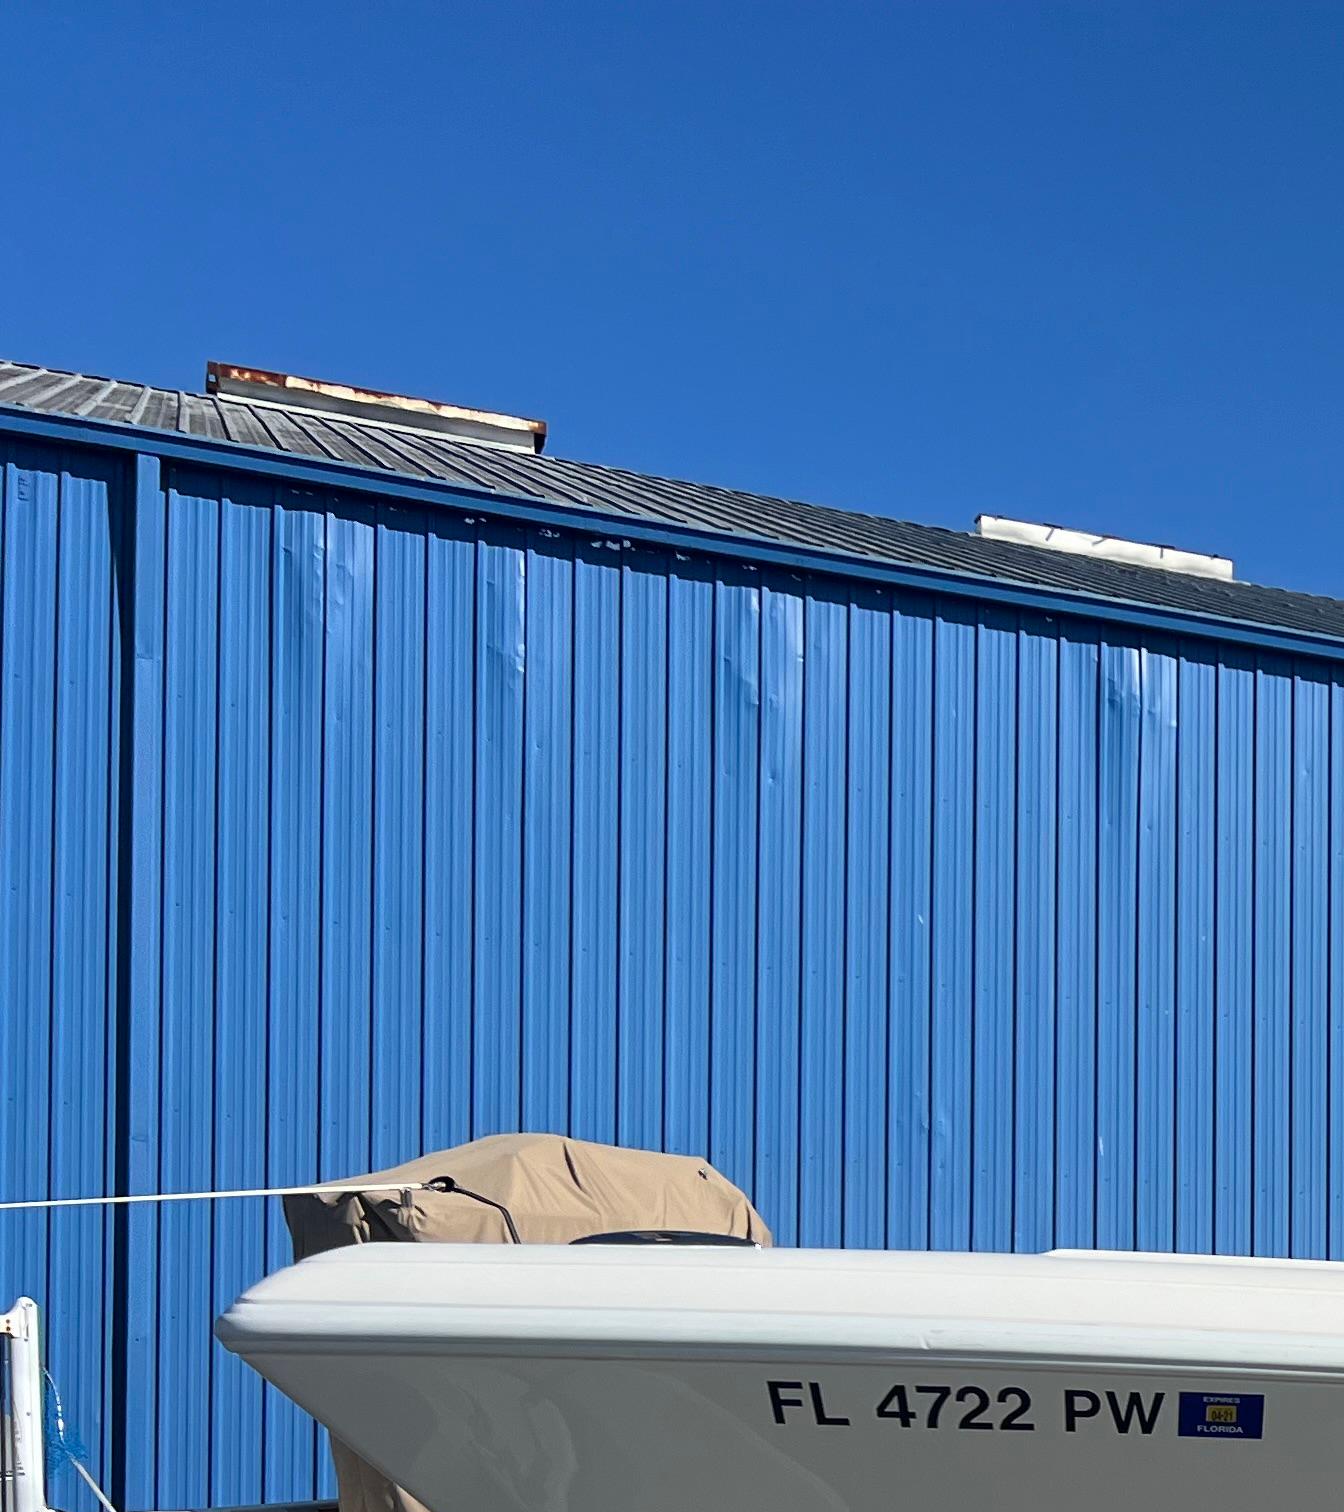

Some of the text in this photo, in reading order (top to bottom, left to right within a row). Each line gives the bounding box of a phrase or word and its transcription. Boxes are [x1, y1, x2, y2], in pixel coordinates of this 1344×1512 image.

[766, 1380, 1166, 1435] FL 4722 PW
[1197, 1424, 1244, 1434] FLORIDA
